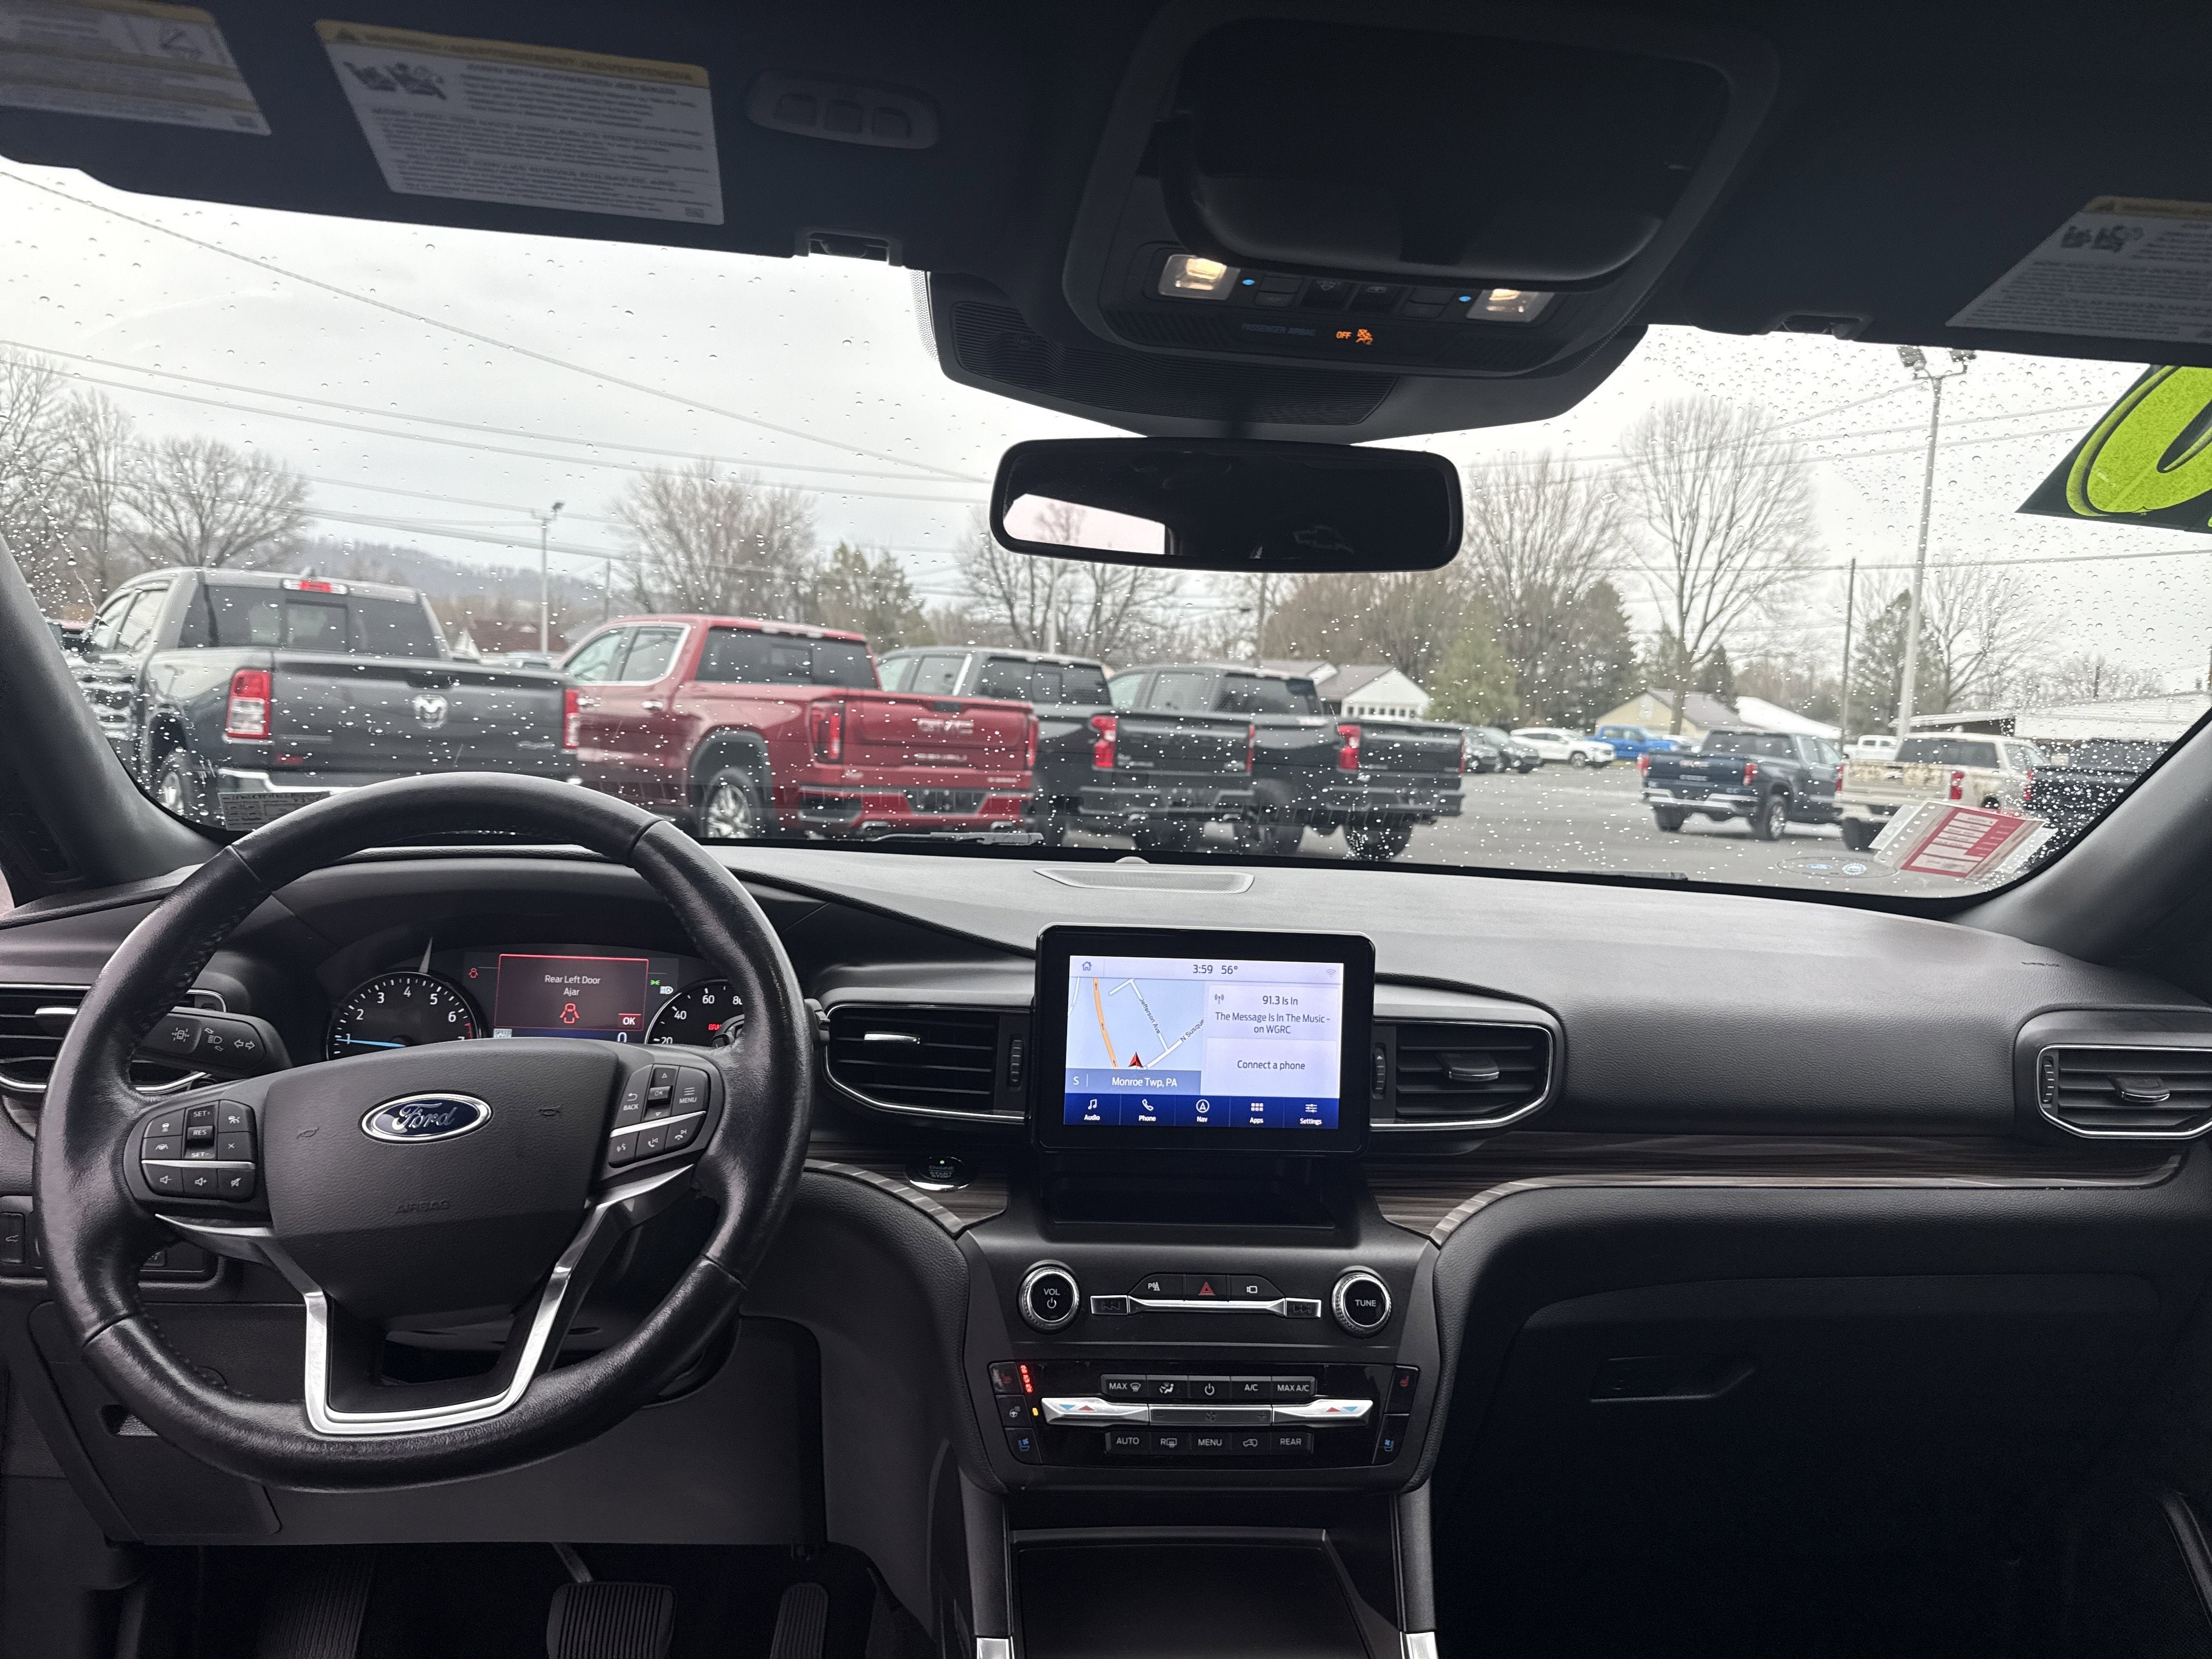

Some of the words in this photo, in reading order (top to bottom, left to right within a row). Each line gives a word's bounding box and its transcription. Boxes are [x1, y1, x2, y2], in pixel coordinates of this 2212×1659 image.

[1242, 323, 1285, 334] PASSENGER
[1288, 328, 1316, 336] AIRBAG
[1336, 331, 1352, 339] OFF
[917, 718, 974, 735] GMC
[1193, 964, 1213, 974] 3:59
[1221, 965, 1238, 975] 56°
[545, 975, 563, 983] Rear
[564, 975, 580, 984] Left
[582, 976, 601, 984] Door
[403, 986, 411, 997] 4
[563, 988, 580, 996] Ajar
[377, 992, 385, 1003] 3
[430, 994, 438, 1005] 5
[702, 995, 715, 1004] 60
[1262, 995, 1280, 1005] 91.3
[1282, 996, 1289, 1005] Is
[1290, 997, 1298, 1006] In
[356, 1009, 364, 1020] 2
[448, 1011, 456, 1023] 6
[674, 1011, 687, 1020] 40
[1139, 997, 1155, 1023] Jefferson
[1153, 1022, 1161, 1034] Ave
[1215, 1012, 1231, 1021] The
[1232, 1013, 1267, 1023] Message
[1268, 1013, 1275, 1022] Is
[1277, 1013, 1284, 1023] In
[1285, 1014, 1301, 1023] The
[1302, 1014, 1325, 1023] Music
[622, 1017, 635, 1025] OK
[1185, 1017, 1204, 1037] Susque
[1266, 1025, 1291, 1034] WGRC
[346, 1034, 351, 1044] 1
[617, 1031, 627, 1042] 0
[1237, 1060, 1271, 1069] Connect
[1279, 1061, 1305, 1070] phone
[1073, 1076, 1080, 1085] S
[1111, 1077, 1143, 1086] Monroe
[1144, 1077, 1165, 1088] Twp,
[1166, 1078, 1177, 1087] PA
[392, 1103, 458, 1130] Ford
[395, 1200, 450, 1214] AIRBAG
